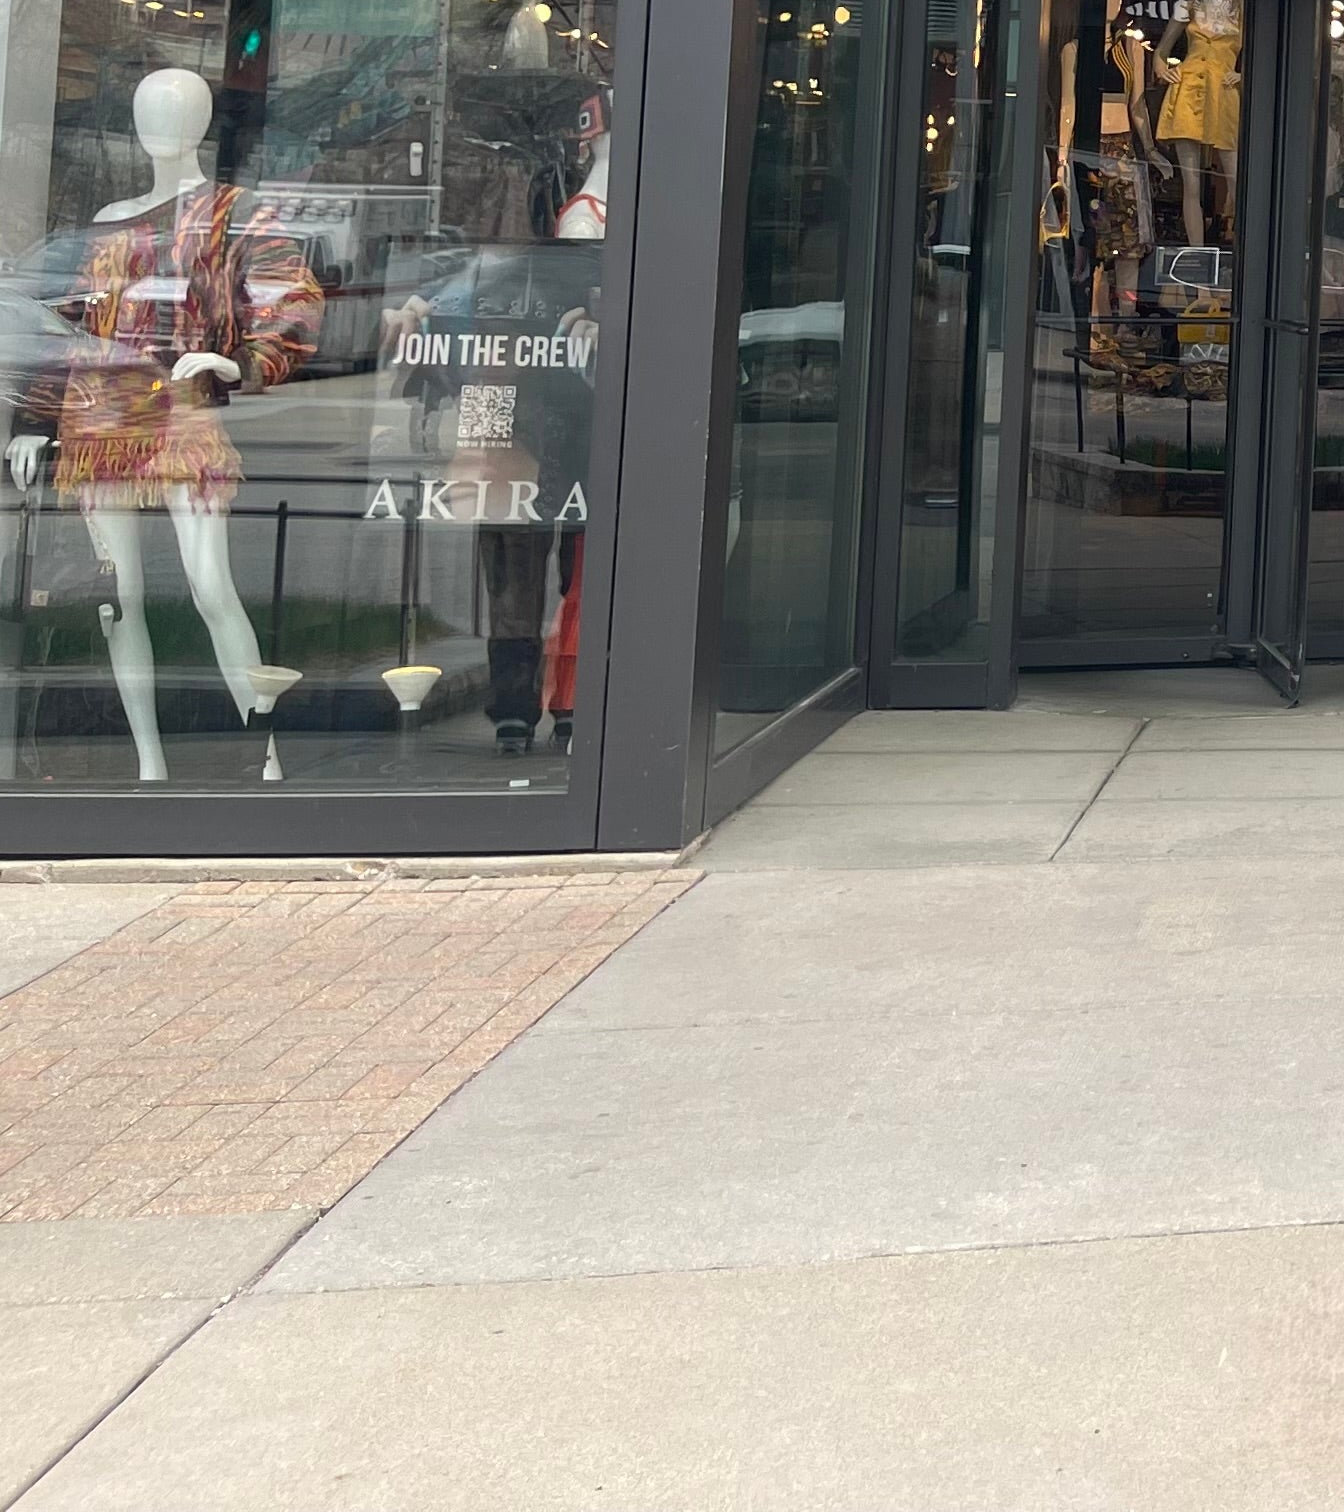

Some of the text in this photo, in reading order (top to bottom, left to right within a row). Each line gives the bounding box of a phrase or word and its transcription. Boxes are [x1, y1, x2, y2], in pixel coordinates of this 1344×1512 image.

[391, 333, 592, 369] JOIN THE CREW
[457, 440, 513, 449] NOW HIRING
[363, 478, 589, 522] AKIRA
